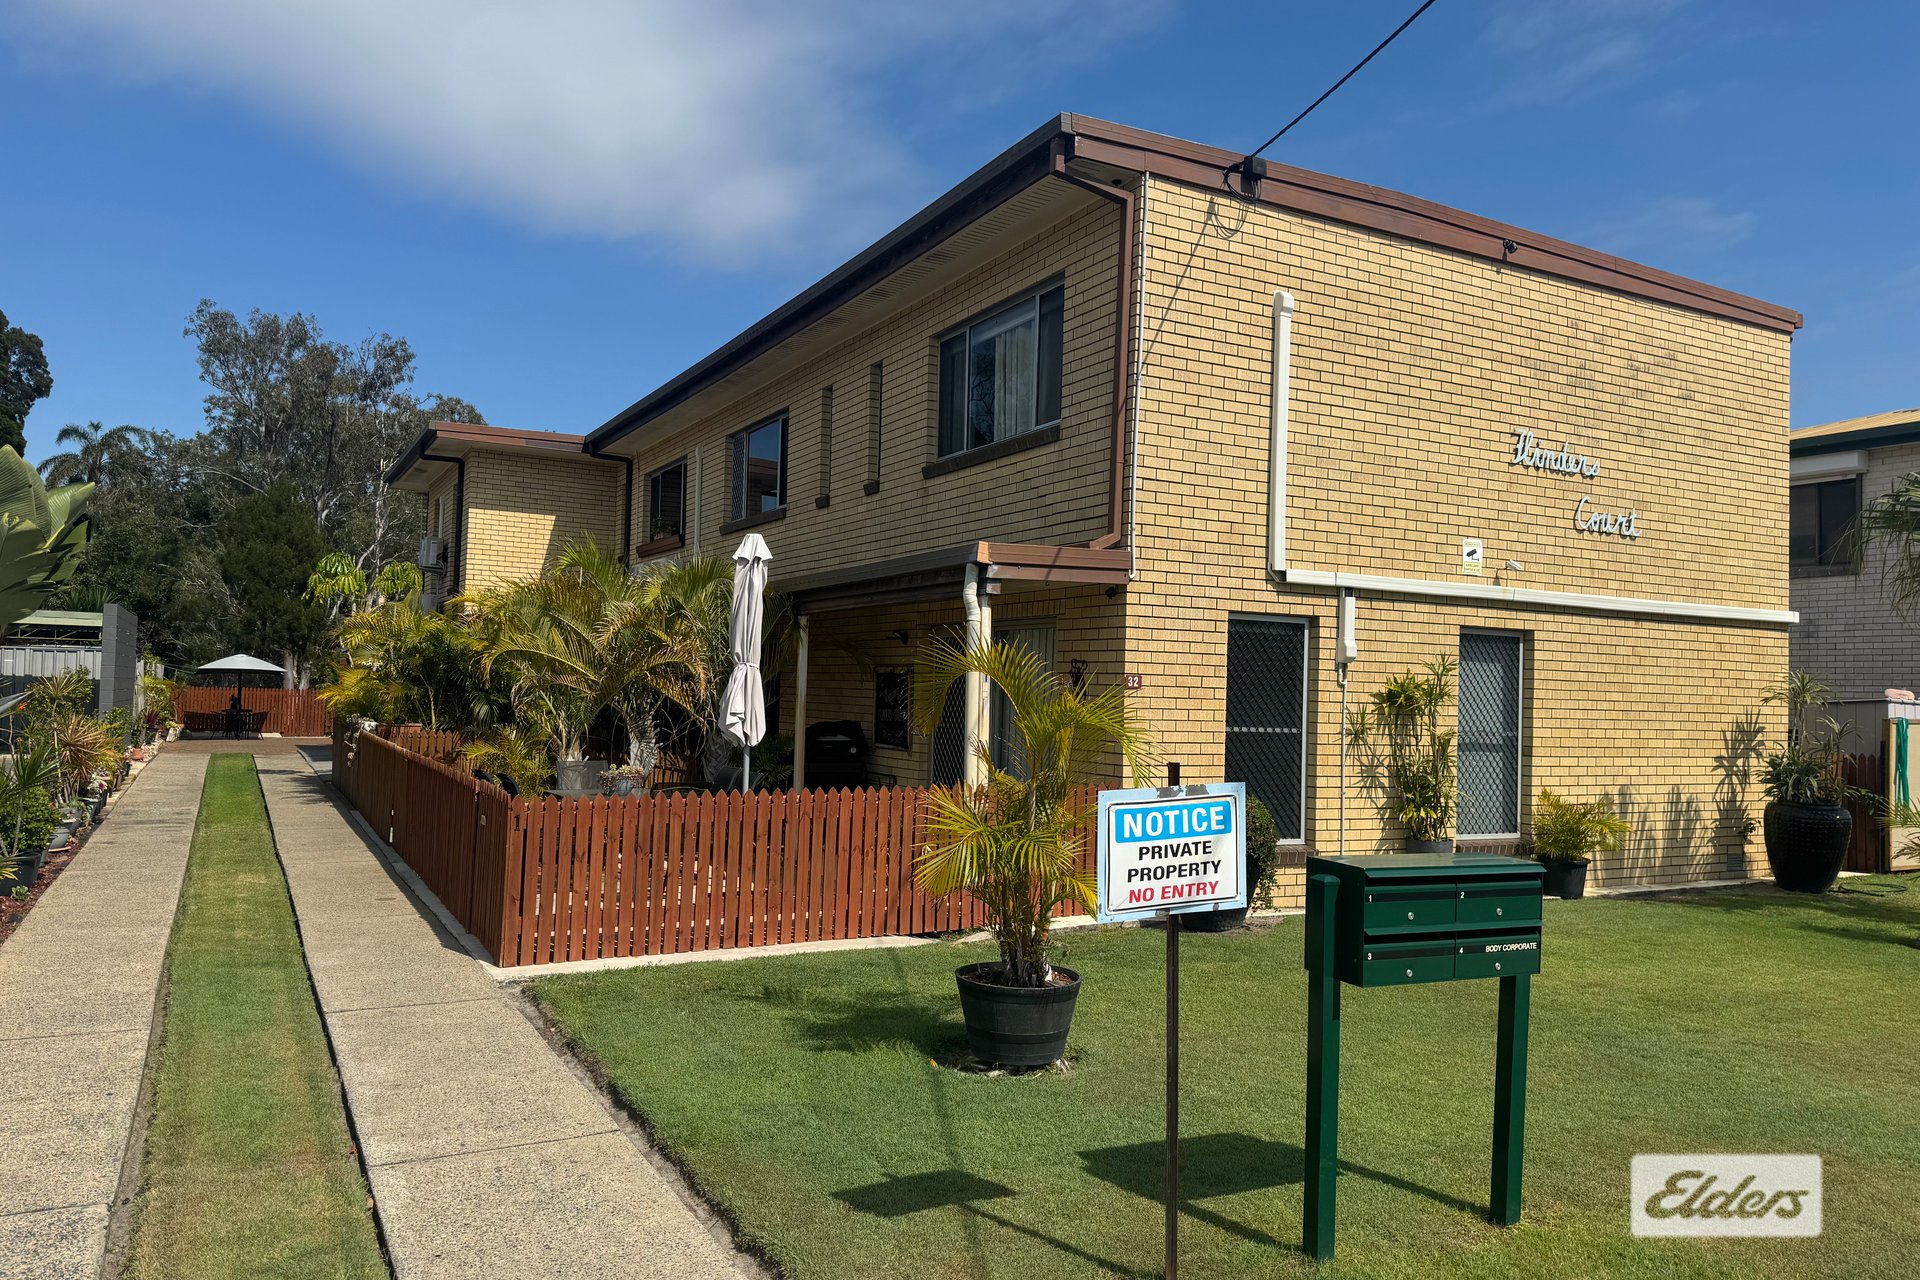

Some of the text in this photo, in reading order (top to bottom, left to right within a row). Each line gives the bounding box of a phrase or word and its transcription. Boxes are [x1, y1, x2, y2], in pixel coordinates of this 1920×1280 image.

[1576, 495, 1642, 538] Court
[1127, 676, 1139, 687] 32
[514, 815, 520, 832] 1
[1123, 806, 1225, 838] NOTICE
[1138, 840, 1213, 861] PRIVATE
[1127, 860, 1222, 883] PROPERTY
[1128, 880, 1219, 904] NO ENTRY
[1502, 942, 1537, 951] CORPORATE
